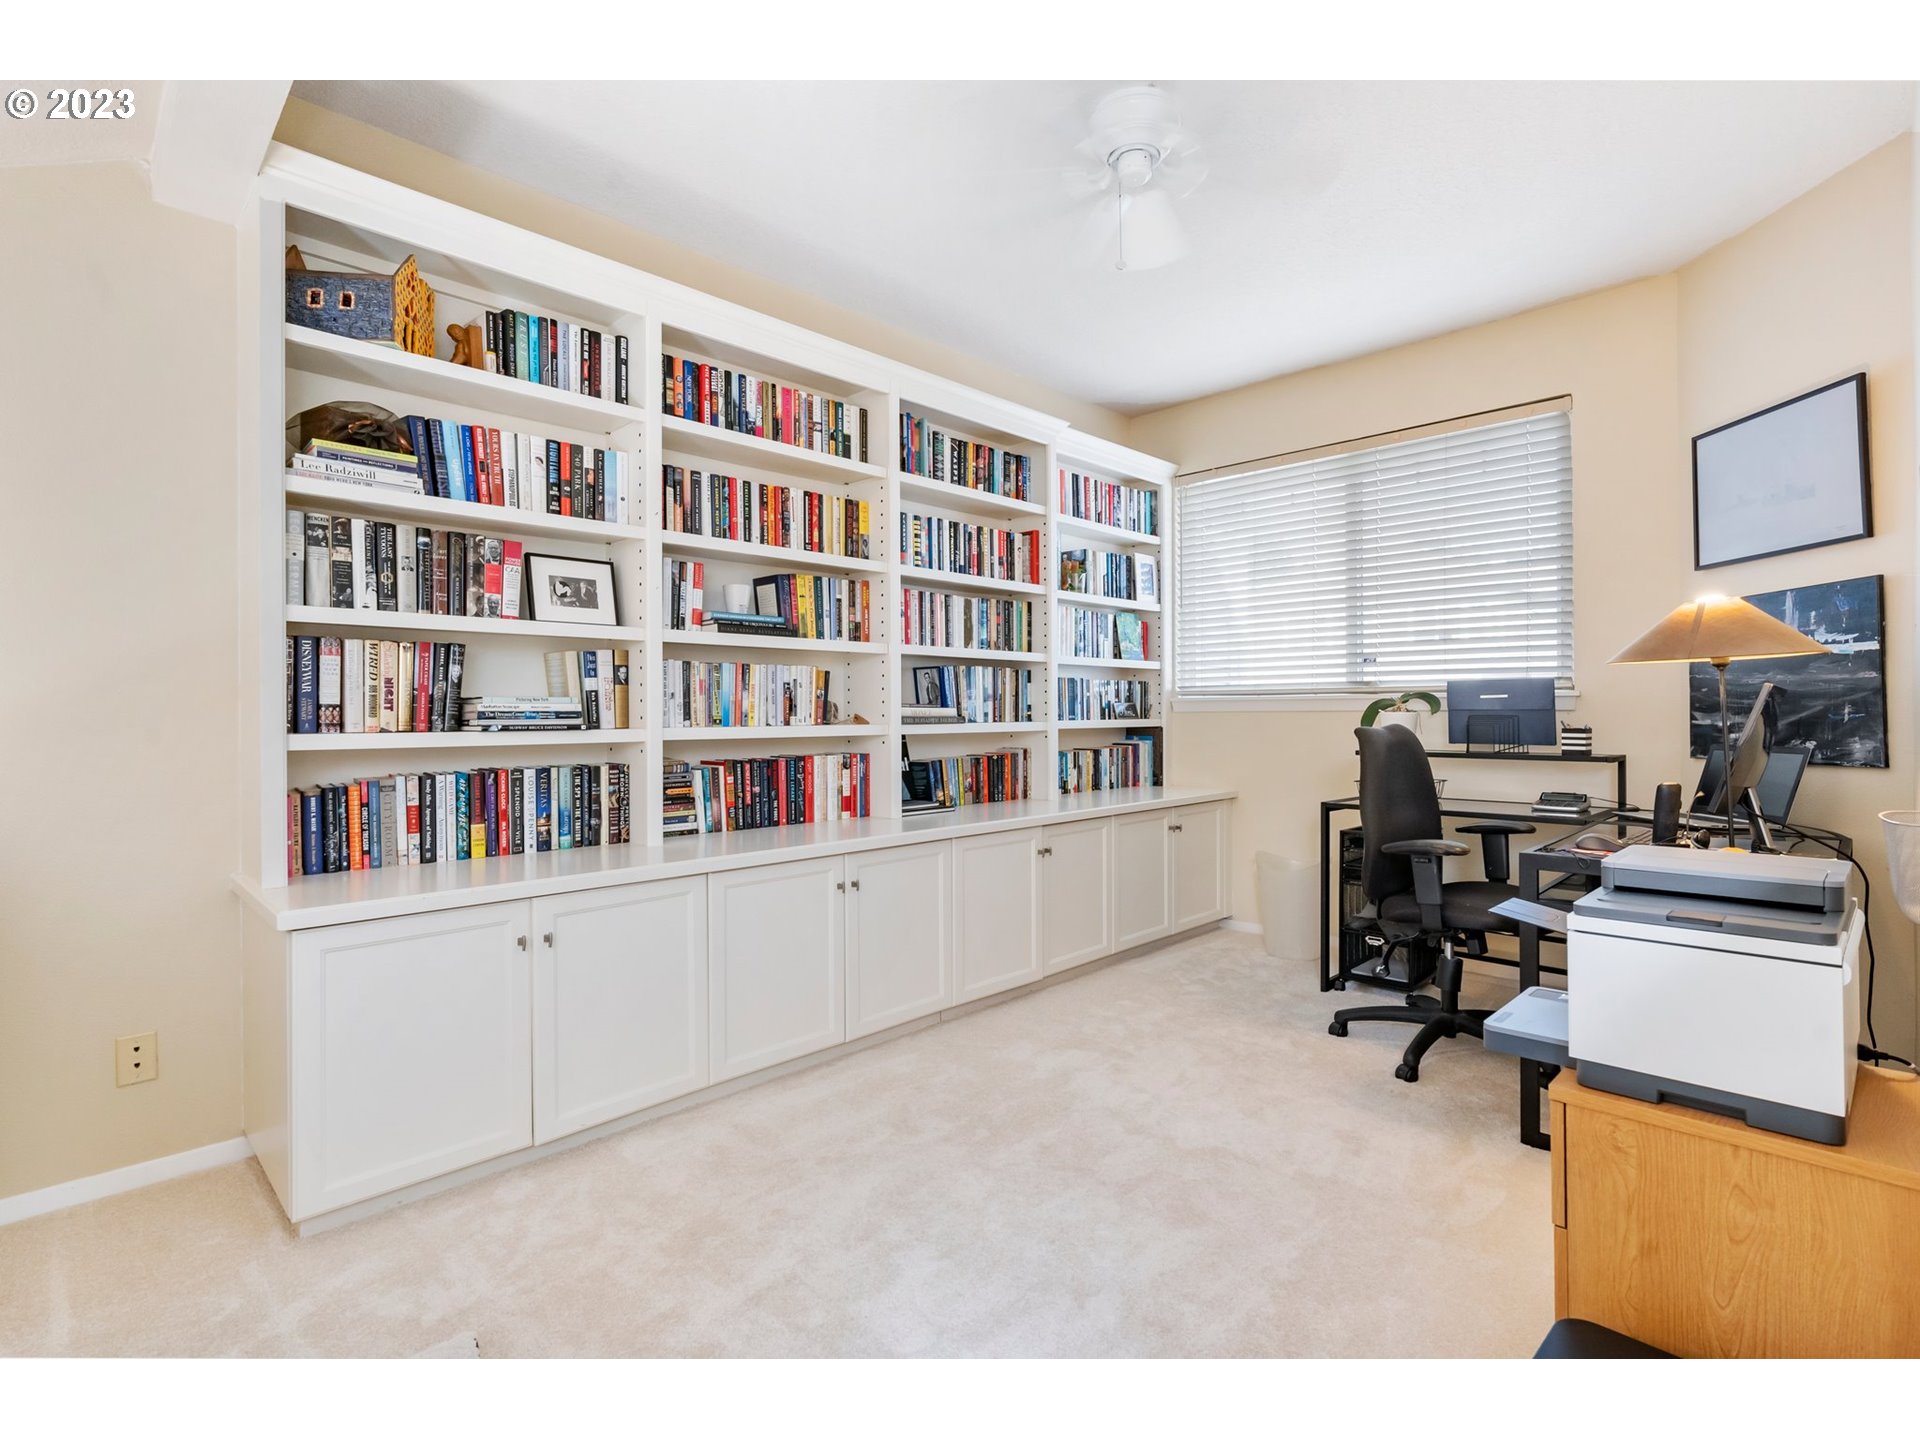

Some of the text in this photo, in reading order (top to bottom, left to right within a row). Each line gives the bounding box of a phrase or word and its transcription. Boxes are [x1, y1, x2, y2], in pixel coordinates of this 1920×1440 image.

[300, 460, 321, 469] Lee
[326, 464, 376, 479] Radziwill
[550, 442, 559, 483] NIGHTLINE
[508, 469, 516, 507] STEPHANOPOULOS
[302, 640, 312, 693] DISNEYWAR
[369, 643, 378, 681] WIRED
[384, 677, 394, 711] NIGHT
[383, 793, 392, 821] CITY
